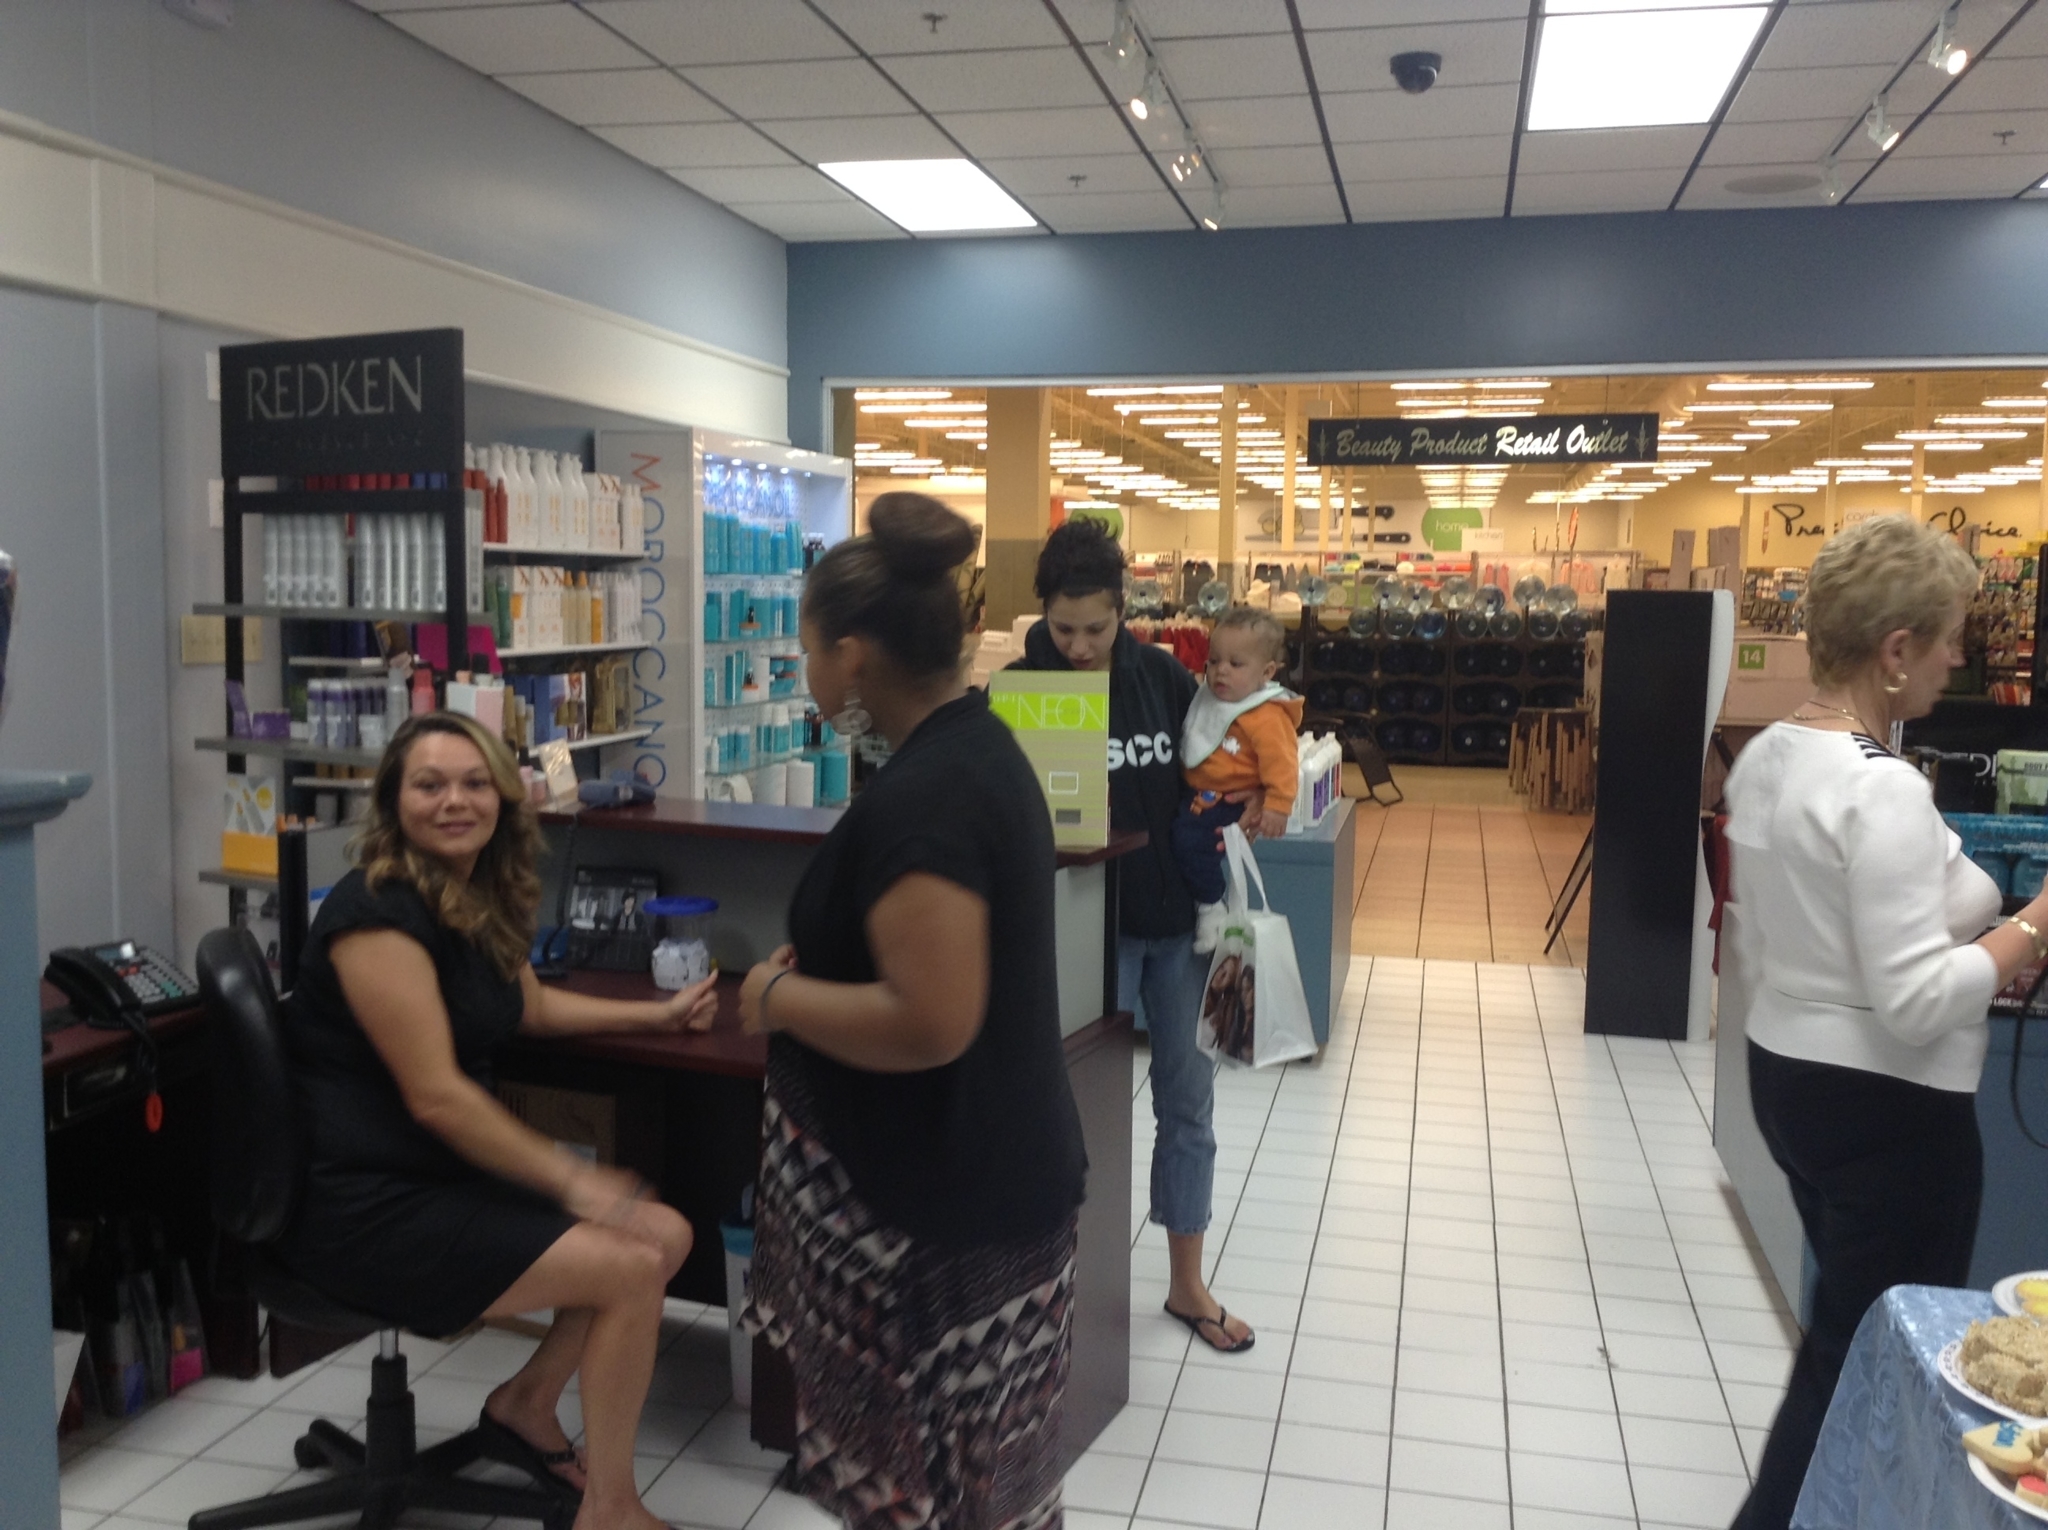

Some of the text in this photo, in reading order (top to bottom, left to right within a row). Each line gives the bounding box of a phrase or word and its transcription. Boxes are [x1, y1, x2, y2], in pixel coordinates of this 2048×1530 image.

[246, 354, 422, 422] REDKEN
[1336, 424, 1629, 462] Beauty Product Retail Outlet
[1742, 649, 1762, 665] 14
[1017, 693, 1107, 730] NEON
